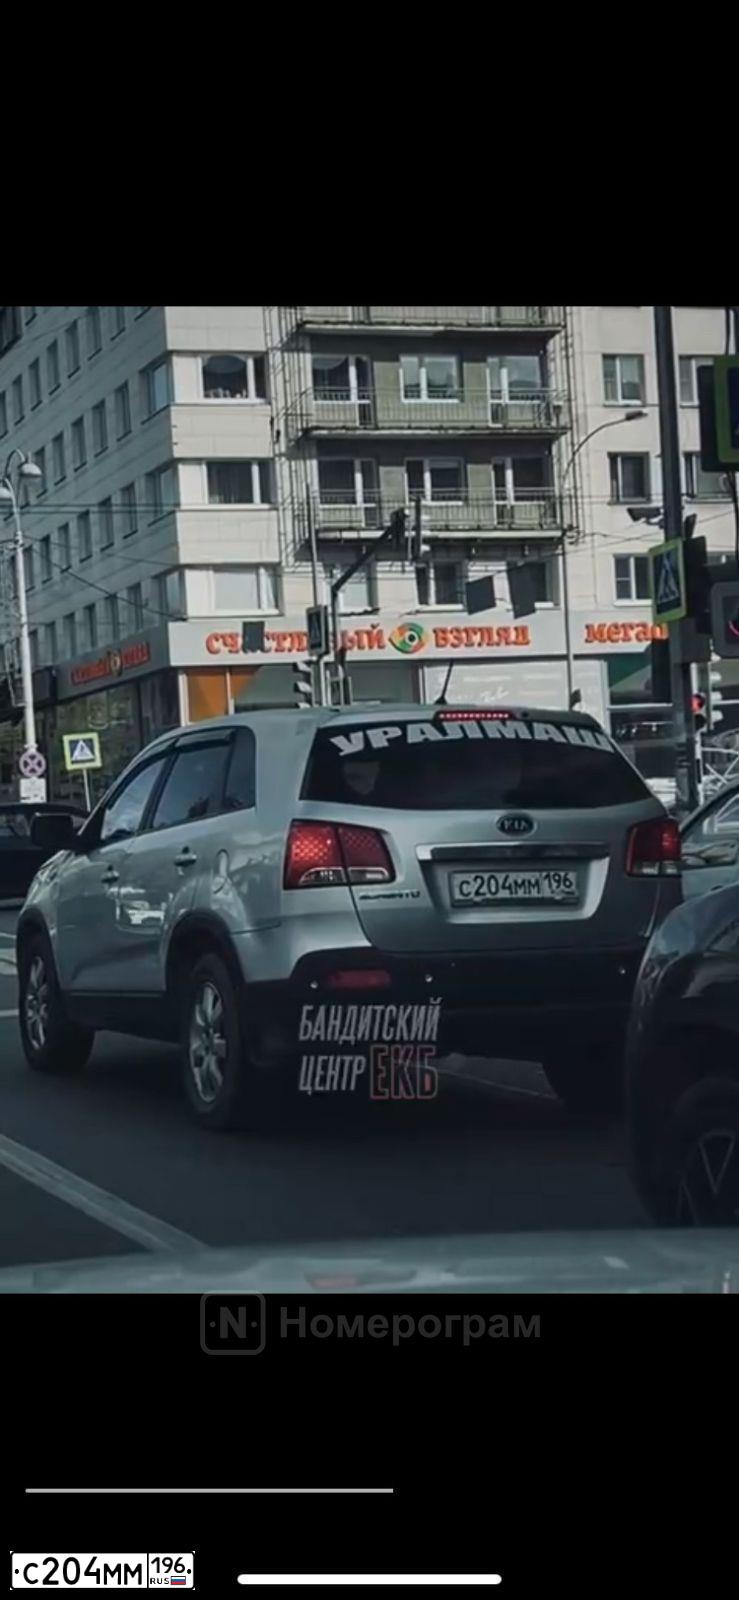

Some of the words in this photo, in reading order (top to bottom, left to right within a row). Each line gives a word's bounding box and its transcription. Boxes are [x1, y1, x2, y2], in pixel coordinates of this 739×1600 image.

[329, 719, 615, 754] УРАЛМАШ
[459, 874, 541, 897] С204ММ
[543, 872, 573, 889] 196
